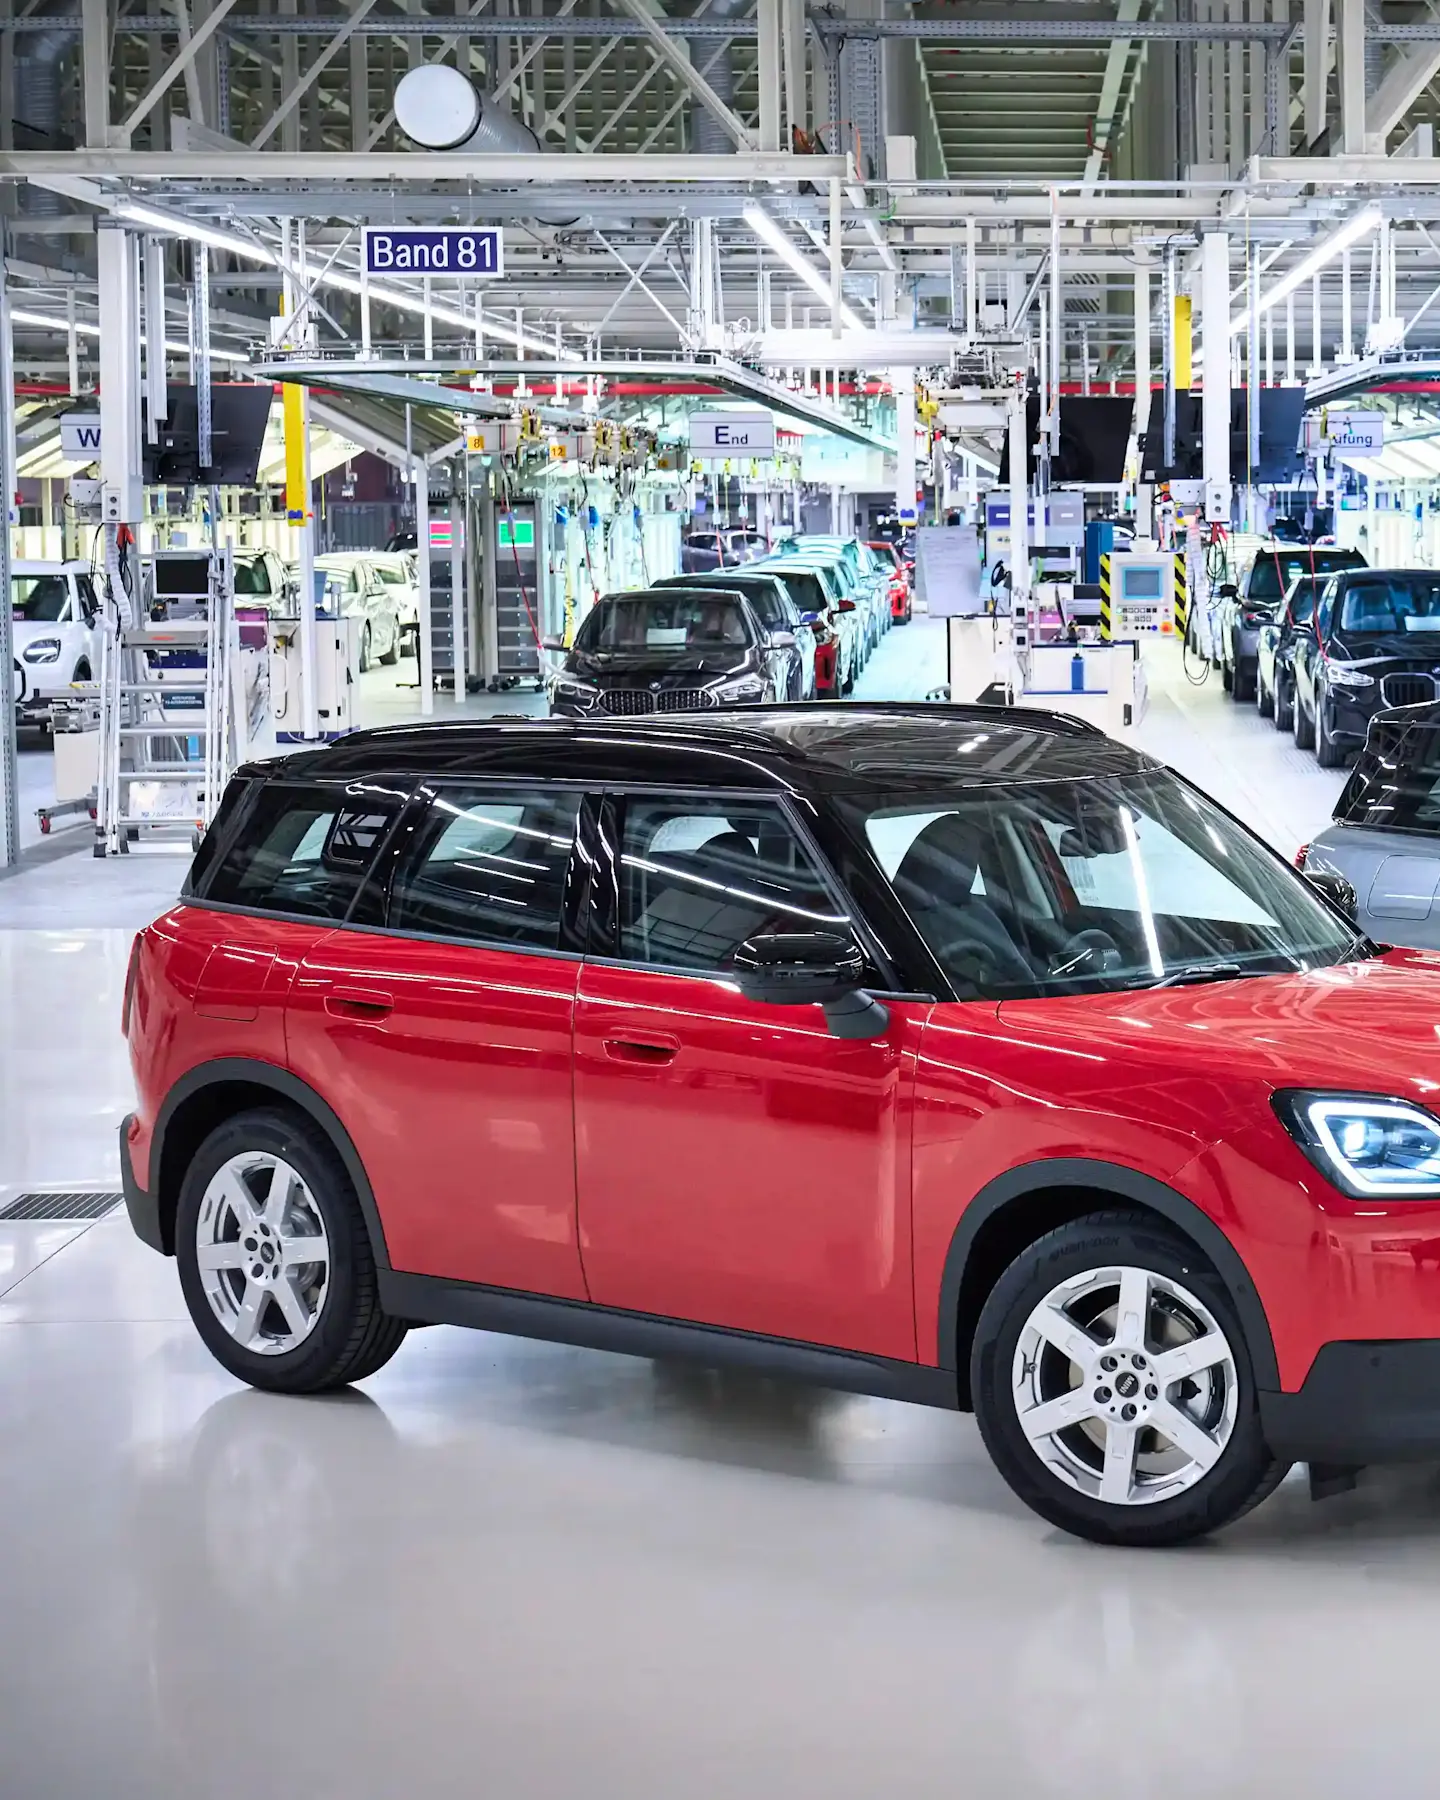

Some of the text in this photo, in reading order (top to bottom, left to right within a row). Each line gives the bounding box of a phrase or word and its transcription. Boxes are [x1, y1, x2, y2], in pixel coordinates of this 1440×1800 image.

[373, 236, 491, 268] Band 81
[714, 426, 748, 445] End
[1119, 1375, 1135, 1394] MINI
